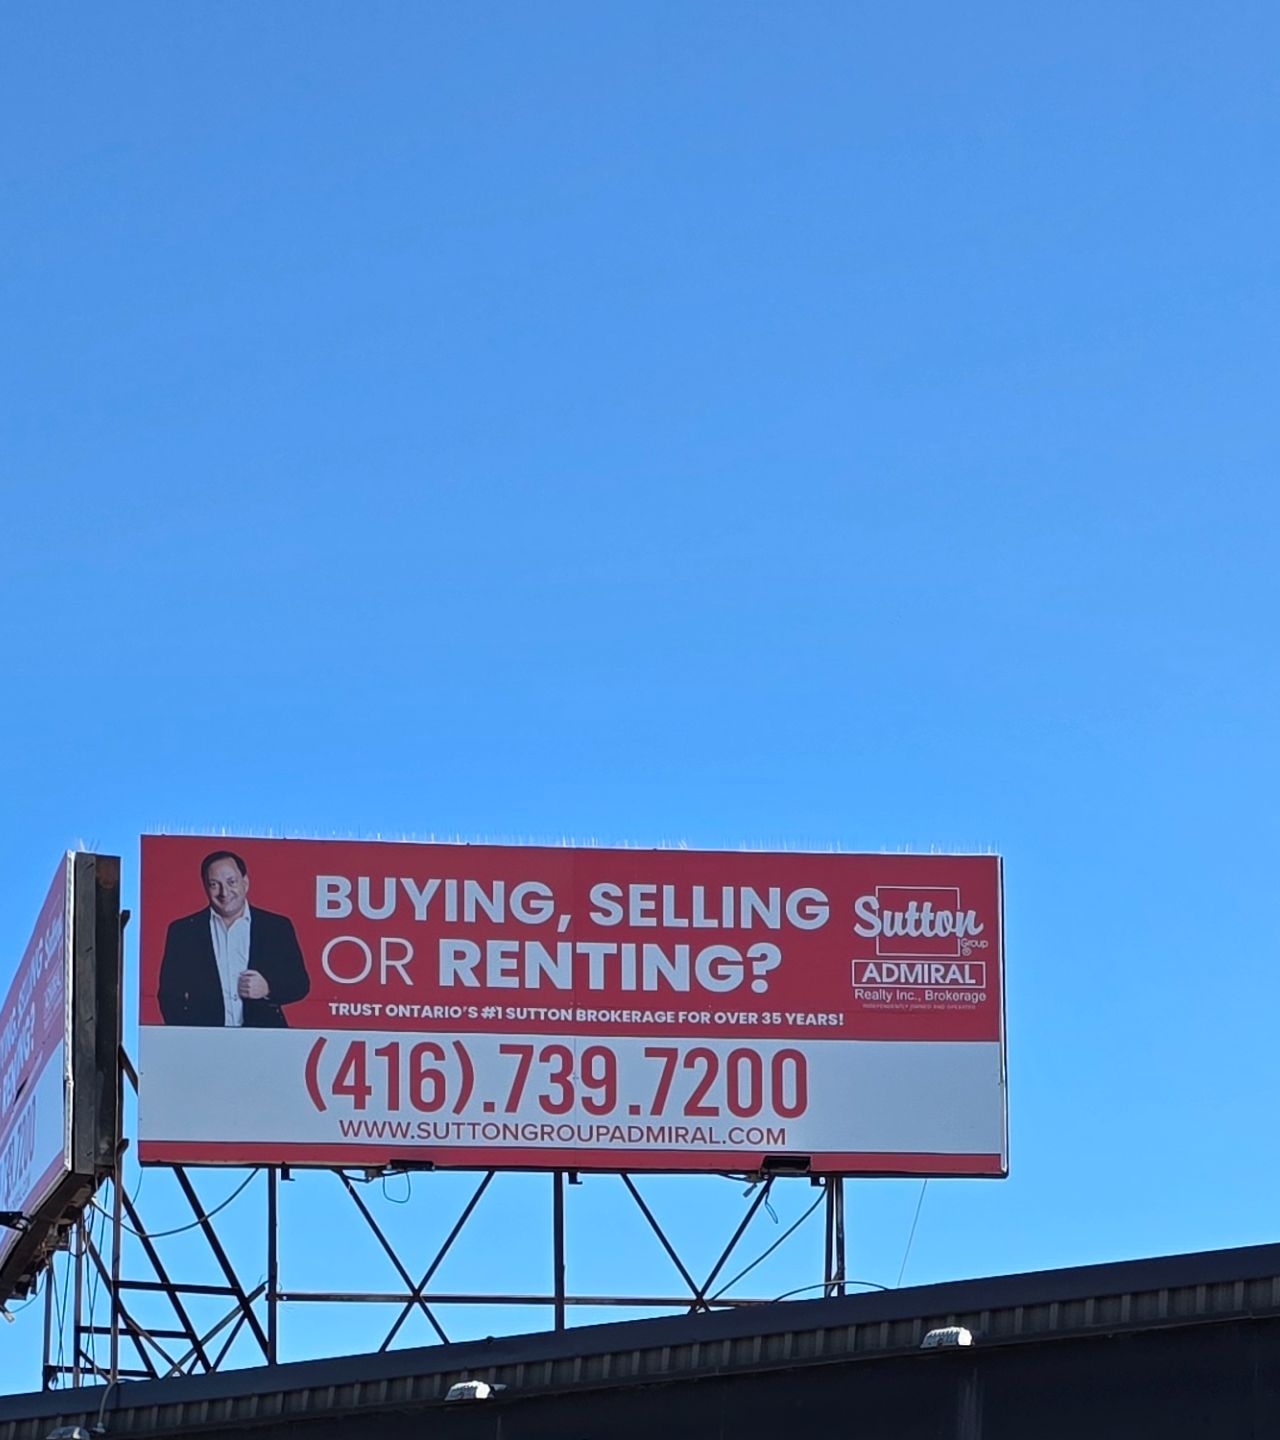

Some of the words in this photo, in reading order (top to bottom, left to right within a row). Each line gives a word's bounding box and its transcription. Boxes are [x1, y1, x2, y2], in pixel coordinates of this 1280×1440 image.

[315, 875, 572, 933] BUYING,
[588, 882, 830, 930] SELLING
[853, 895, 984, 938] Sutton
[960, 937, 988, 949] Group
[321, 935, 414, 985] OR
[438, 938, 782, 993] RENTING?
[861, 962, 976, 984] ADMIRAL
[854, 988, 893, 1003] Realty
[924, 989, 987, 1004] Brokerage
[328, 1002, 383, 1017] TRUST
[385, 1003, 478, 1019] ONTARIO'S
[481, 1005, 503, 1019] #1
[505, 1006, 573, 1021] SUTTON
[576, 1009, 675, 1024] BROKERAGE
[678, 1011, 711, 1025] FOR
[713, 1012, 758, 1025] OVER
[761, 1013, 782, 1025] 35
[785, 1013, 844, 1026] YEARS!
[304, 1036, 808, 1119] (416).739.7200
[338, 1119, 786, 1146] WWW.SUTTONGROUPADMIRAL.COM
